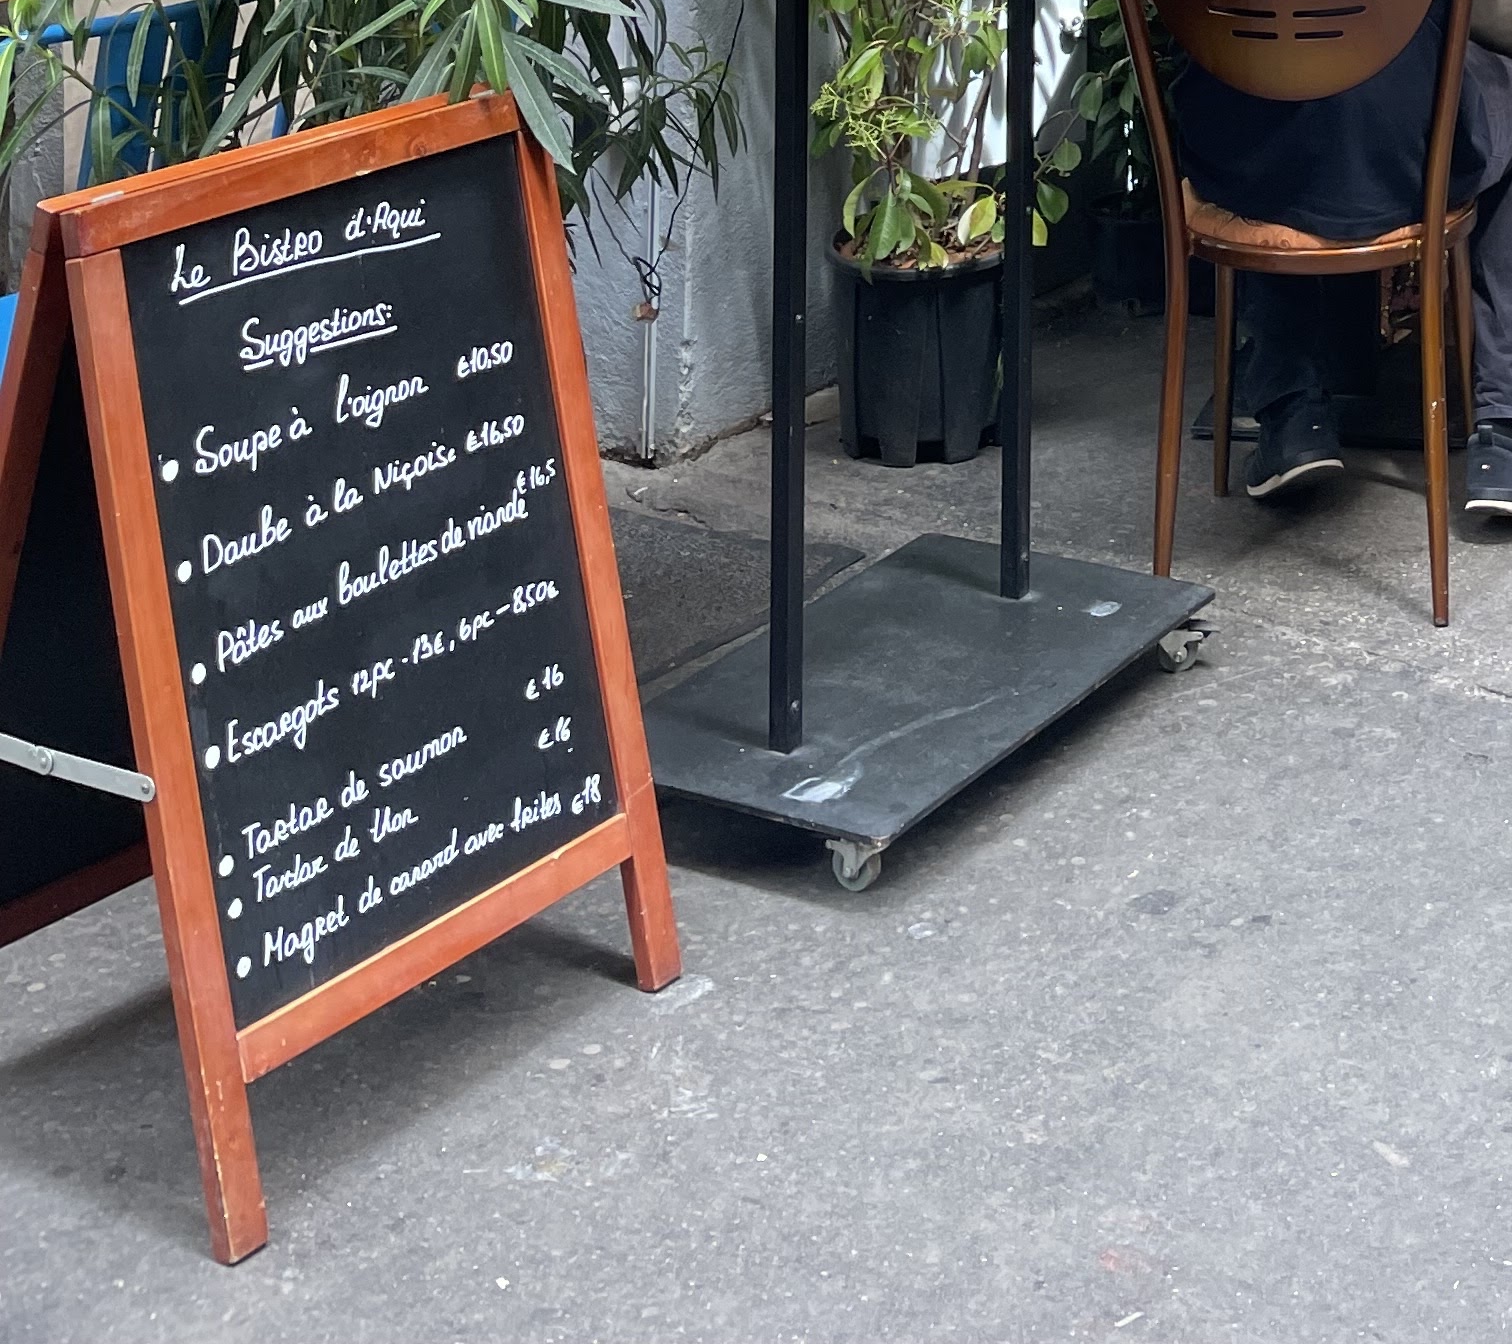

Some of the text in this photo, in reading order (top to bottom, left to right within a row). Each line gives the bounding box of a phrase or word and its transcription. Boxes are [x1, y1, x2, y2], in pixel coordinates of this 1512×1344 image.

[171, 244, 211, 293] Le
[232, 227, 323, 277] Bistro
[195, 424, 283, 474] Soupe
[289, 407, 313, 440] à
[336, 374, 429, 427] l'oignon
[202, 505, 292, 574] Daube
[305, 495, 329, 527] à
[334, 477, 364, 513] la
[374, 441, 457, 494] Niçoise
[217, 622, 285, 673] Pâtes
[292, 596, 329, 629] aux
[338, 539, 438, 605] boulettes
[441, 517, 466, 554] de
[227, 679, 340, 763] Escargots
[241, 798, 335, 860] Tartar
[340, 770, 370, 808] de
[252, 853, 329, 903] Tartar
[334, 825, 361, 862] de
[369, 805, 419, 843] thon
[263, 895, 350, 966] Magret
[358, 875, 384, 914] de
[389, 828, 460, 895] canard
[463, 823, 505, 855] avec
[509, 791, 562, 835] frites
